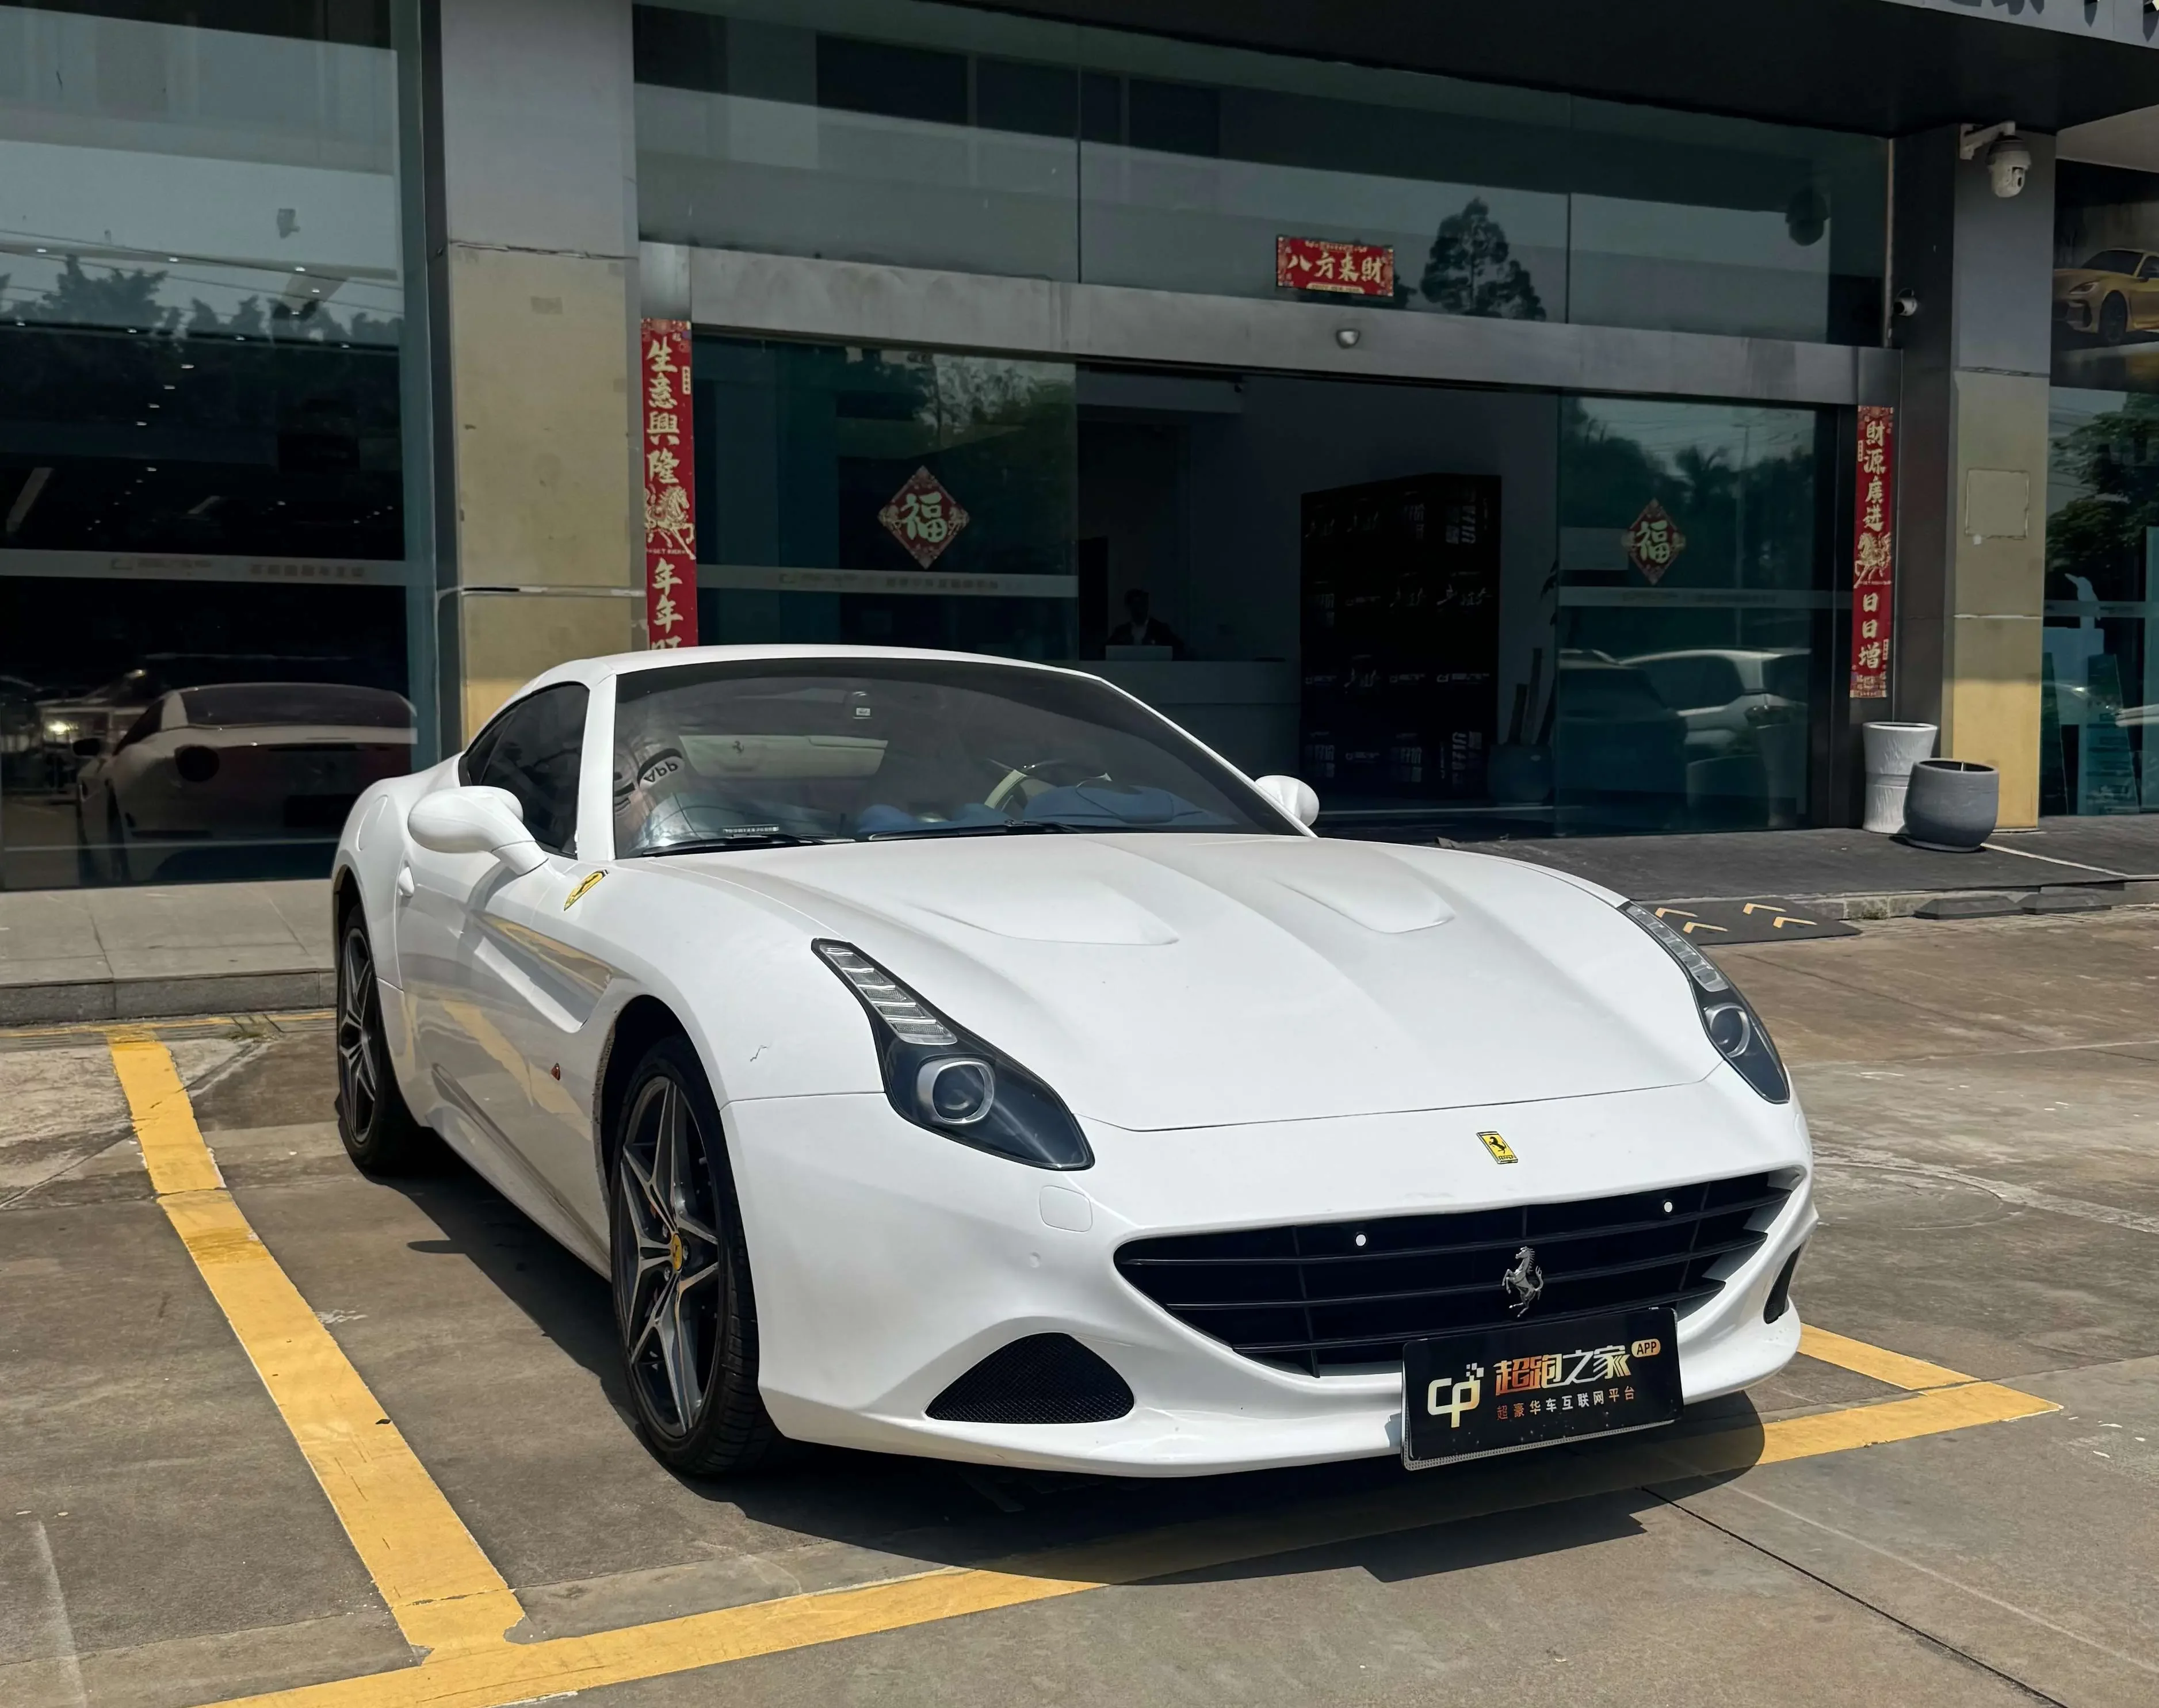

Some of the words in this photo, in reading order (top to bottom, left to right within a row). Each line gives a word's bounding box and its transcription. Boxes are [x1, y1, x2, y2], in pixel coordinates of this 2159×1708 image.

[646, 336, 681, 484] 生意興隆
[900, 491, 947, 542] 福
[1636, 520, 1670, 564] 福
[651, 557, 683, 649] 年年
[1858, 593, 1881, 668] 日日增
[1493, 1345, 1631, 1396] 超跑之家
[1637, 1341, 1657, 1355] APP
[1496, 1385, 1635, 1420] 超豪华车互联网平台
